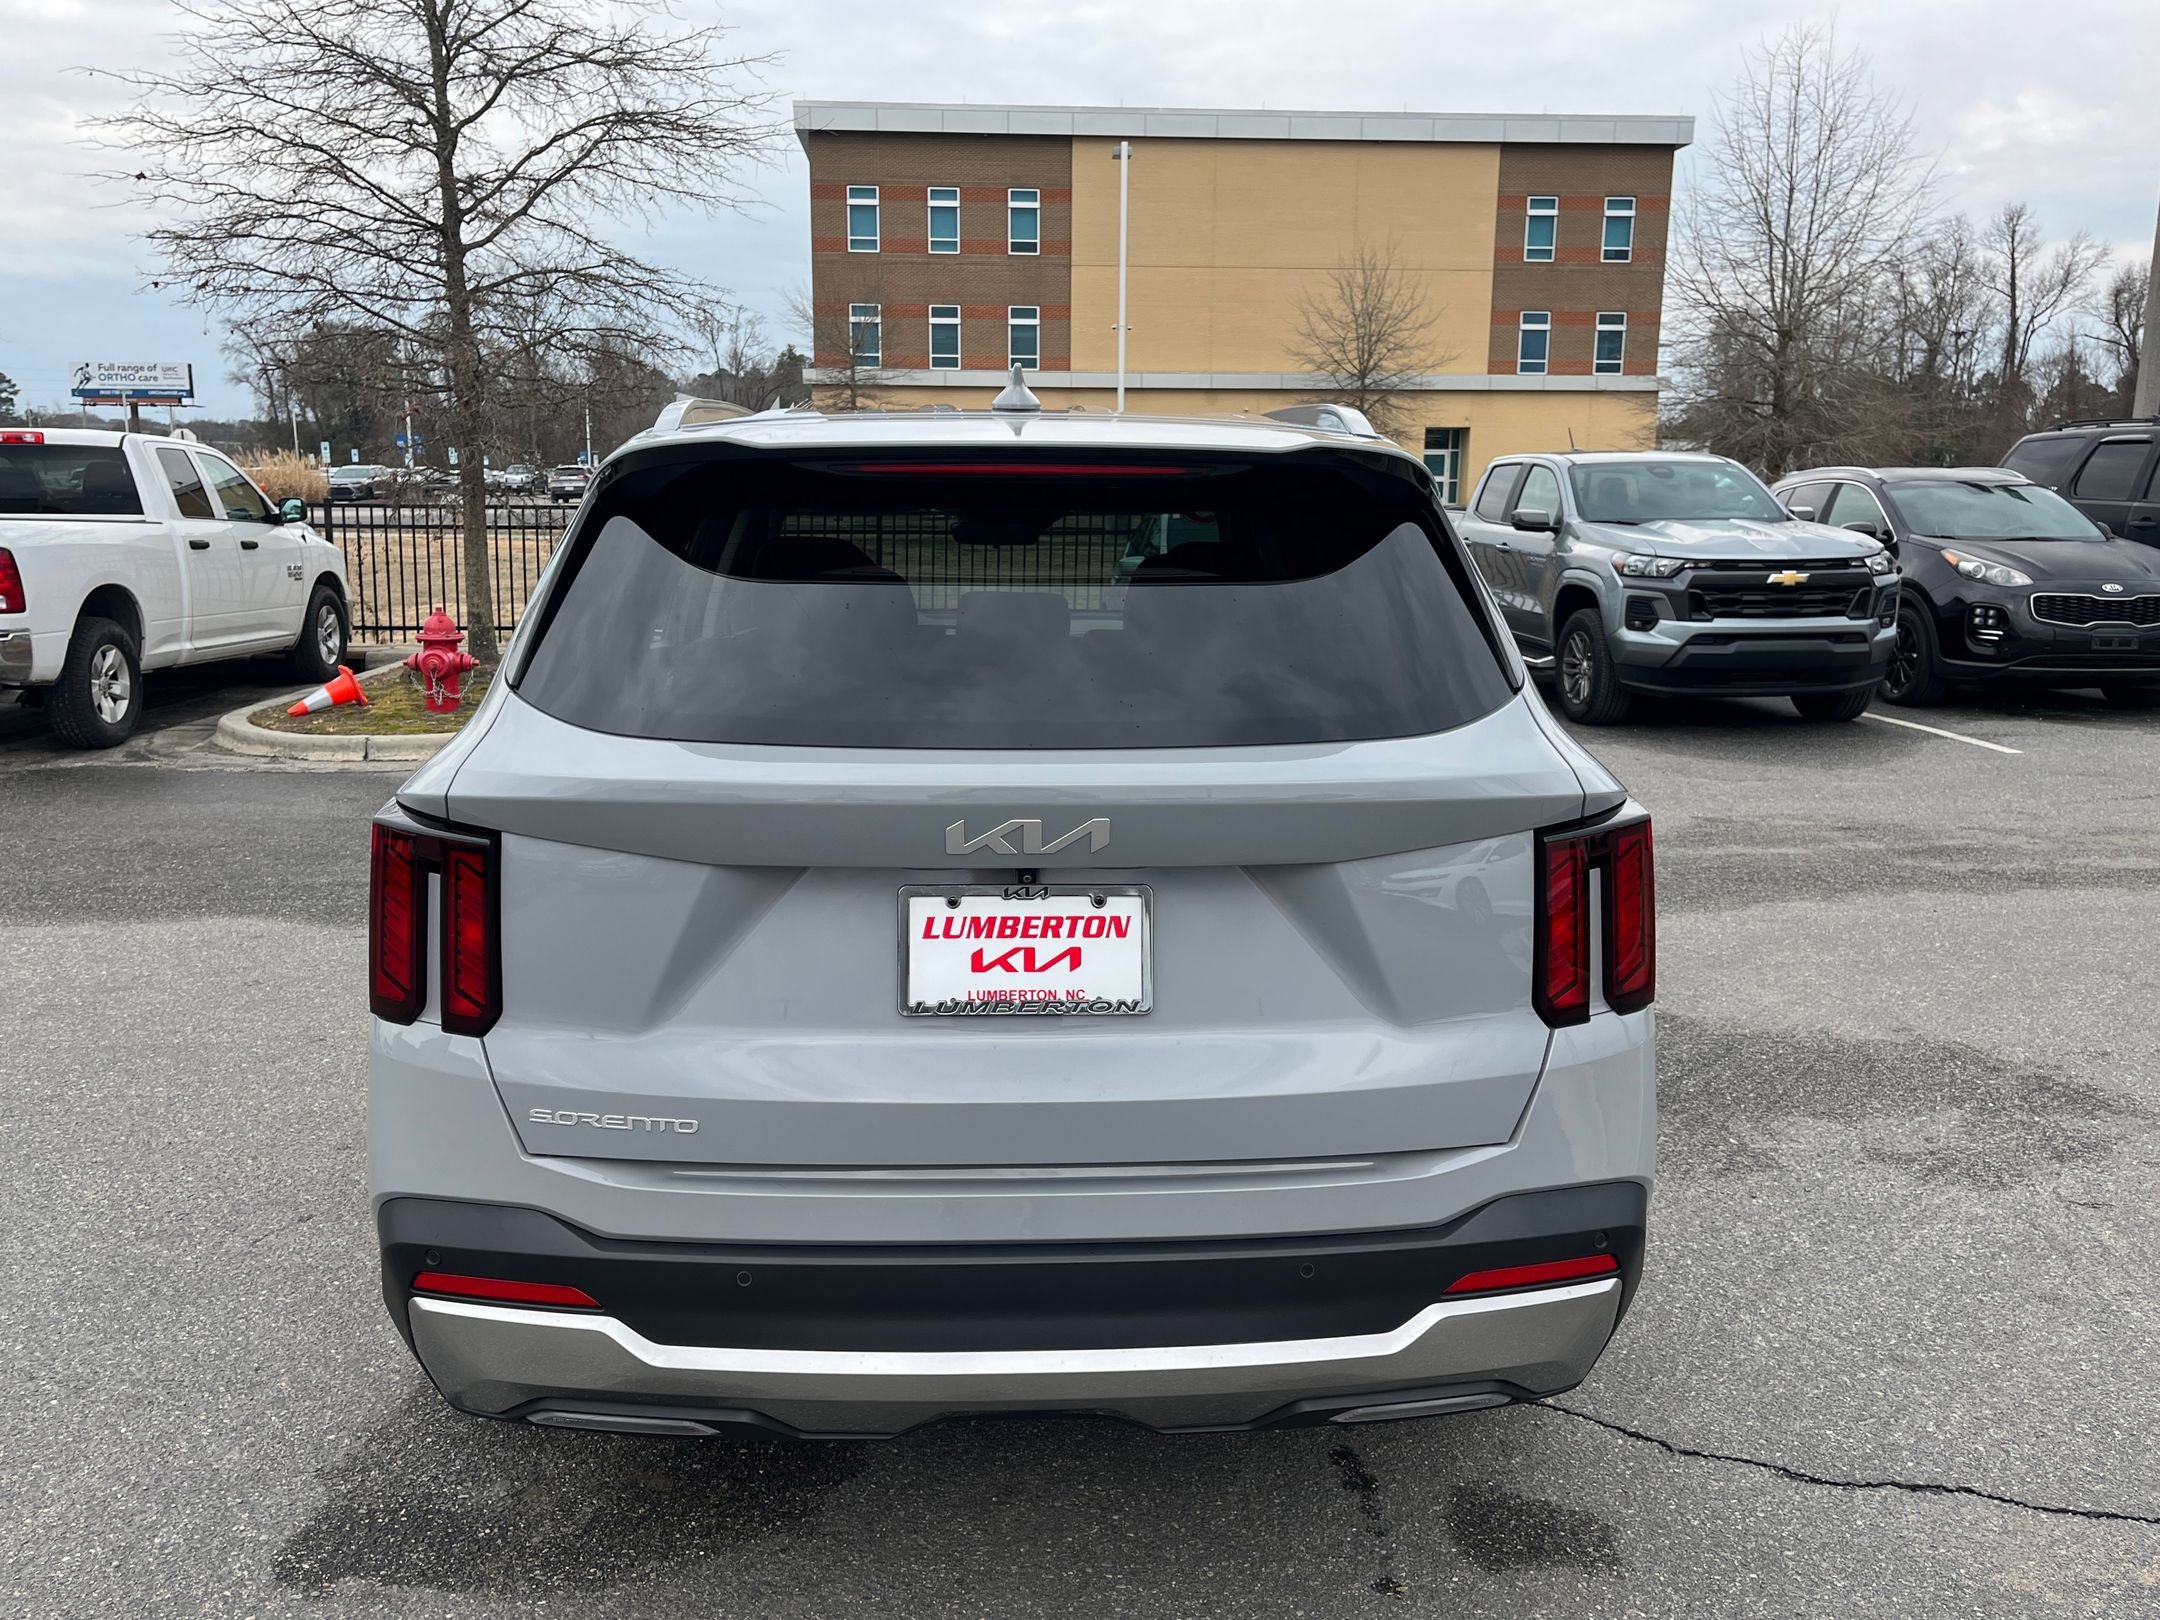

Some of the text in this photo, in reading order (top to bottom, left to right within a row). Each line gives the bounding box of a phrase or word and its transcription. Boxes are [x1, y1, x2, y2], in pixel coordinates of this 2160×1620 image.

[98, 363, 158, 374] Full range of
[98, 373, 136, 382] ORTHO
[945, 817, 1111, 855] KIA
[1002, 886, 1050, 900] KIA
[922, 915, 1132, 940] LUMBERTON
[971, 946, 1082, 973] KIA
[1065, 989, 1086, 1000] NC
[911, 999, 1143, 1015] LUMBERTON
[529, 1108, 699, 1134] SORENTO
